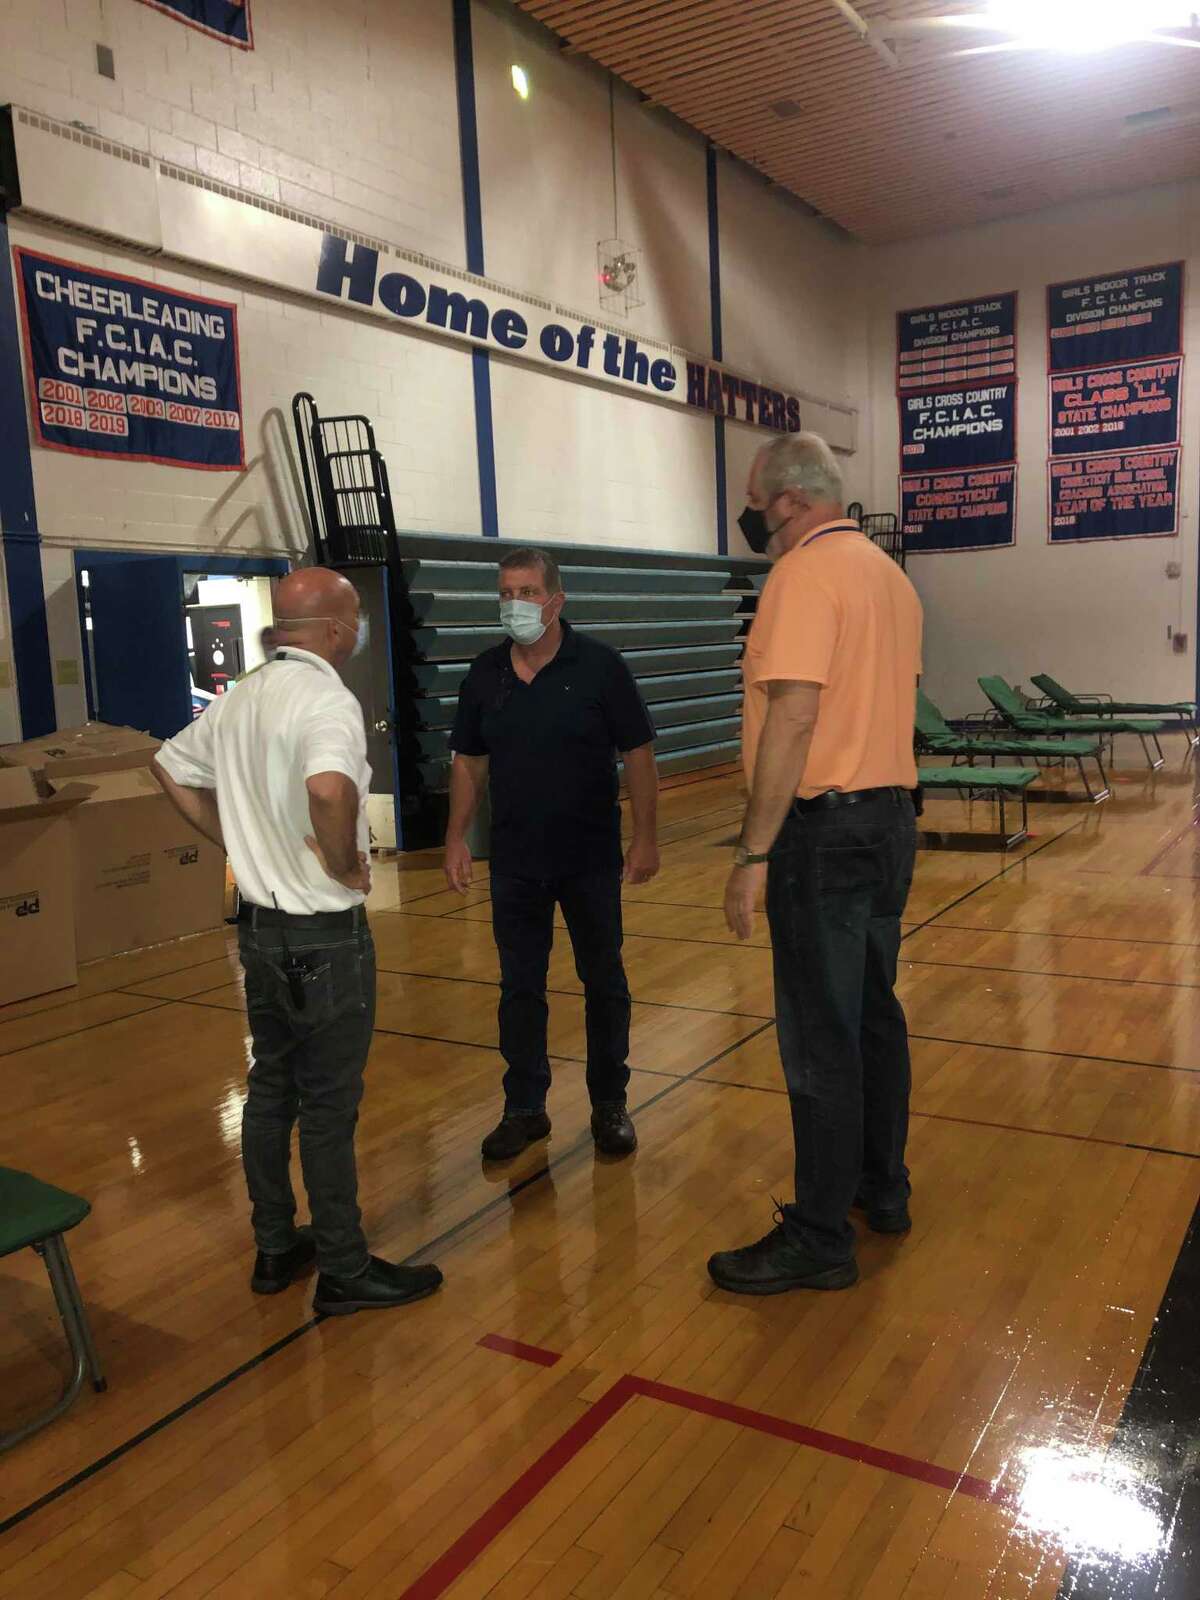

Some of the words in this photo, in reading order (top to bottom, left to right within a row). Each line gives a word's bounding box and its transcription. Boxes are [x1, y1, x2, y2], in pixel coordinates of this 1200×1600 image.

[1134, 271, 1166, 285] TRACK
[35, 270, 226, 339] CHEERLEADING
[1066, 307, 1105, 323] DIVISION
[1109, 298, 1163, 316] CHAMPIONS
[315, 232, 529, 349] Home
[539, 323, 595, 369] of
[603, 334, 677, 391] the
[687, 361, 801, 432] HATTERS
[57, 346, 217, 400] CHAMPIONS
[41, 381, 83, 407] 2001
[86, 389, 125, 412] 2002
[130, 396, 165, 418] 2003
[168, 404, 201, 425] 2007
[204, 409, 238, 429] 2017
[907, 396, 933, 411] GIRLS
[934, 393, 964, 408] CROSS
[966, 386, 1008, 404] COUNTRY
[43, 404, 84, 428] 2018
[88, 413, 126, 434] 2019
[913, 418, 1004, 441] CHAMPIONS
[1056, 499, 1088, 516] TEAM
[1089, 498, 1106, 512] OF
[1110, 496, 1135, 511] THE
[1138, 492, 1173, 509] YEAR
